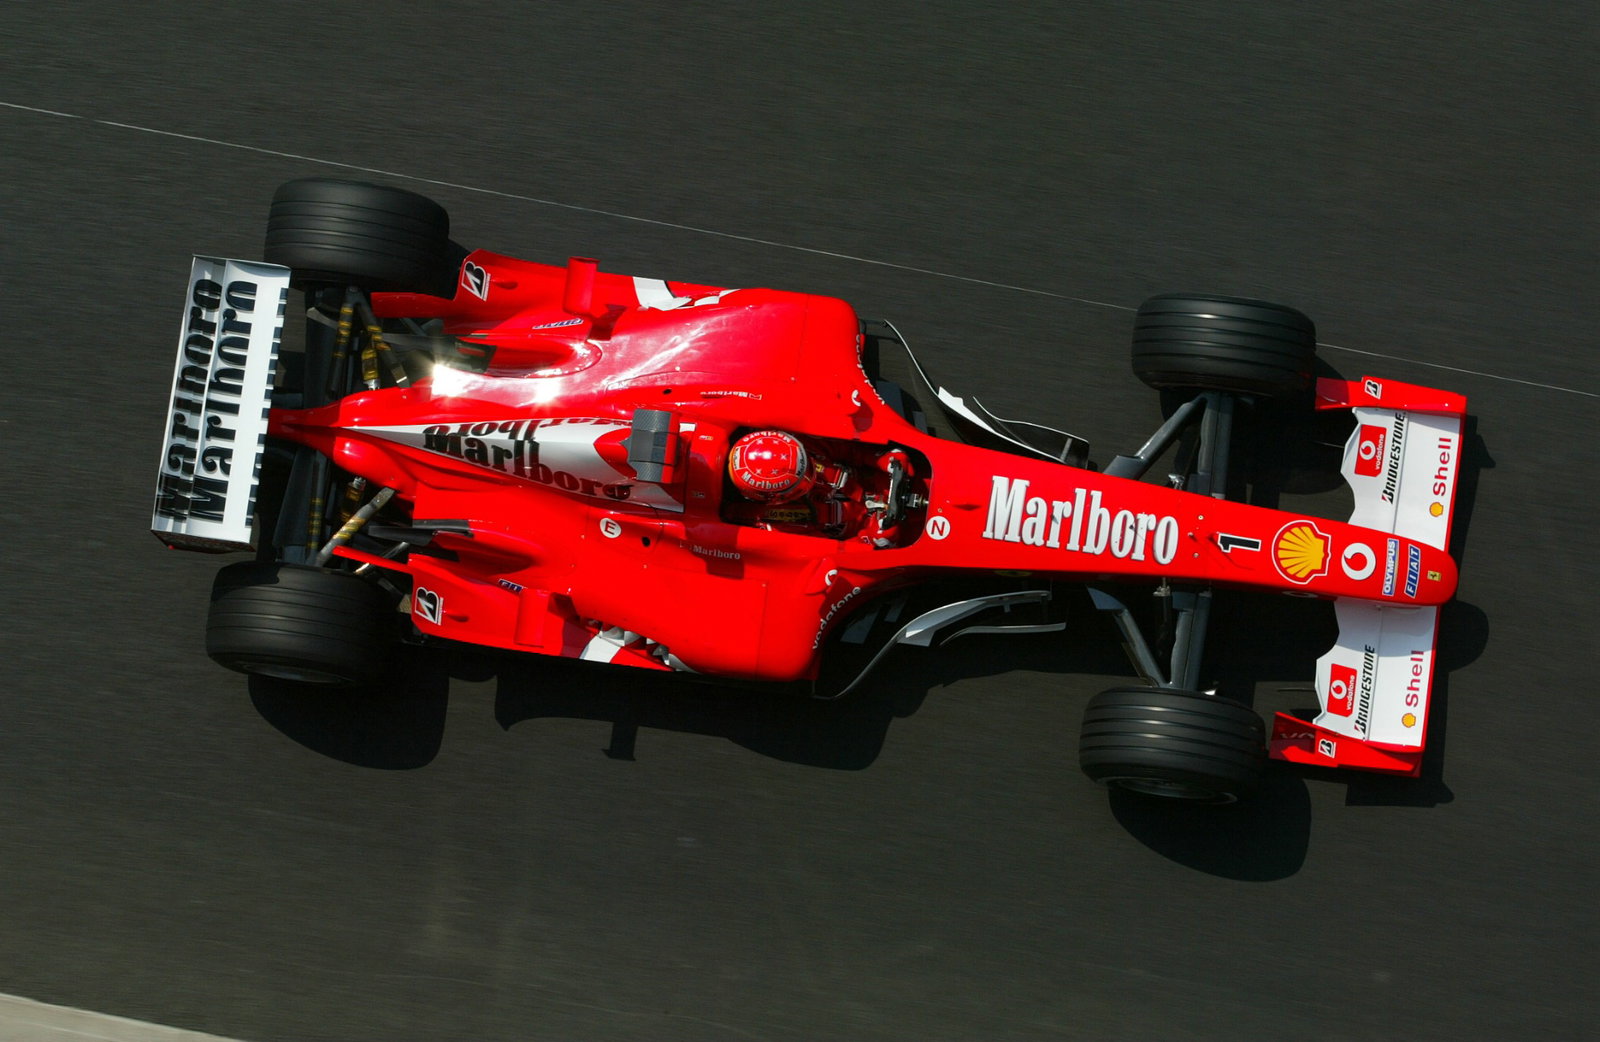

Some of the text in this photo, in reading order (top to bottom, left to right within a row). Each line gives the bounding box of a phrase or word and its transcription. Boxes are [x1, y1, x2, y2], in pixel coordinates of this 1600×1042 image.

[190, 280, 257, 524] Marlboro
[424, 433, 633, 499] Marlboro
[1375, 434, 1385, 470] vodafone
[1381, 412, 1406, 504] BRIDGESTONE
[1433, 437, 1452, 497] Shell
[741, 471, 790, 489] Marlboro
[930, 519, 945, 537] N
[982, 475, 1179, 565] Marlboro
[1218, 532, 1261, 553] 1
[693, 545, 741, 560] Marlboro
[1384, 541, 1396, 593] OLYMPUS
[1406, 547, 1418, 594] FIAT
[812, 586, 861, 649] vodafone
[1346, 674, 1355, 710] vodafone
[1354, 644, 1376, 734] BRIDGESTONE
[1405, 650, 1424, 708] Shell
